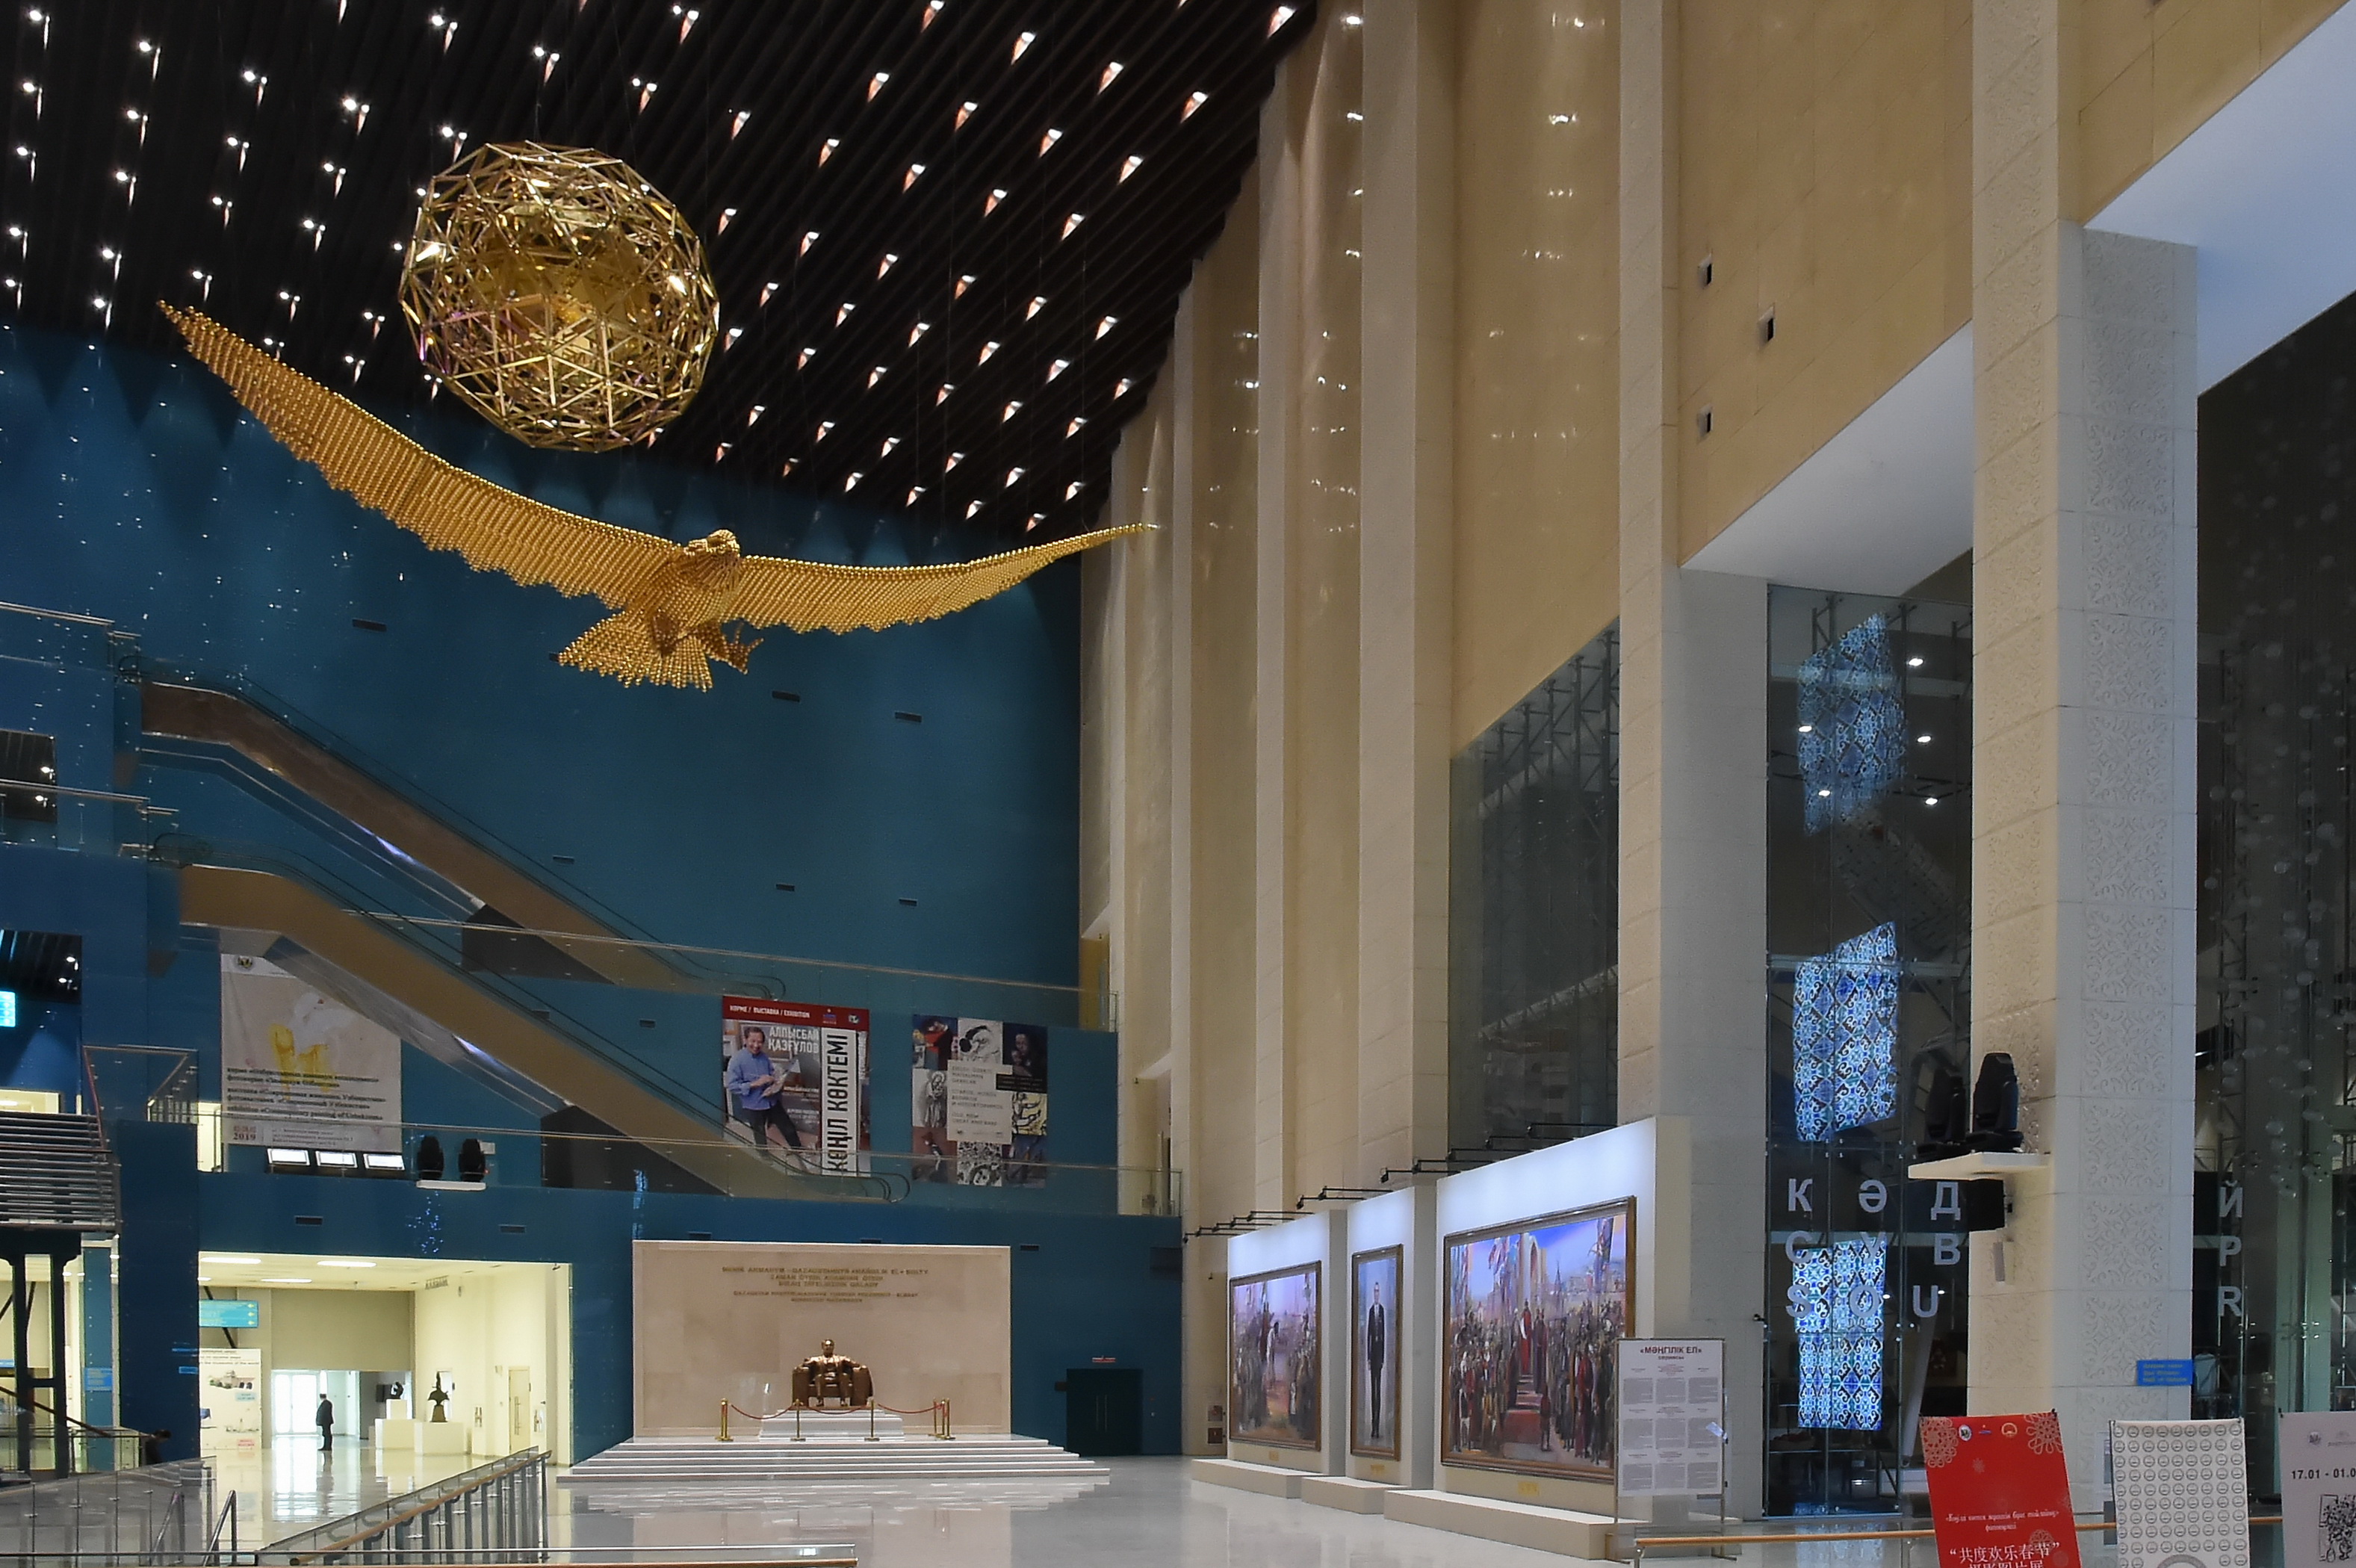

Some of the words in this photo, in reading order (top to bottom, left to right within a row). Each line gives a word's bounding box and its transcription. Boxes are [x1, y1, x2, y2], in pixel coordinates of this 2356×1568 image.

[769, 1026, 819, 1041] АЛПЫСБАЙ
[827, 1034, 848, 1112] КӨКТЕМІ
[233, 1132, 256, 1141] 2019
[2291, 1469, 2320, 1480] 17.01
